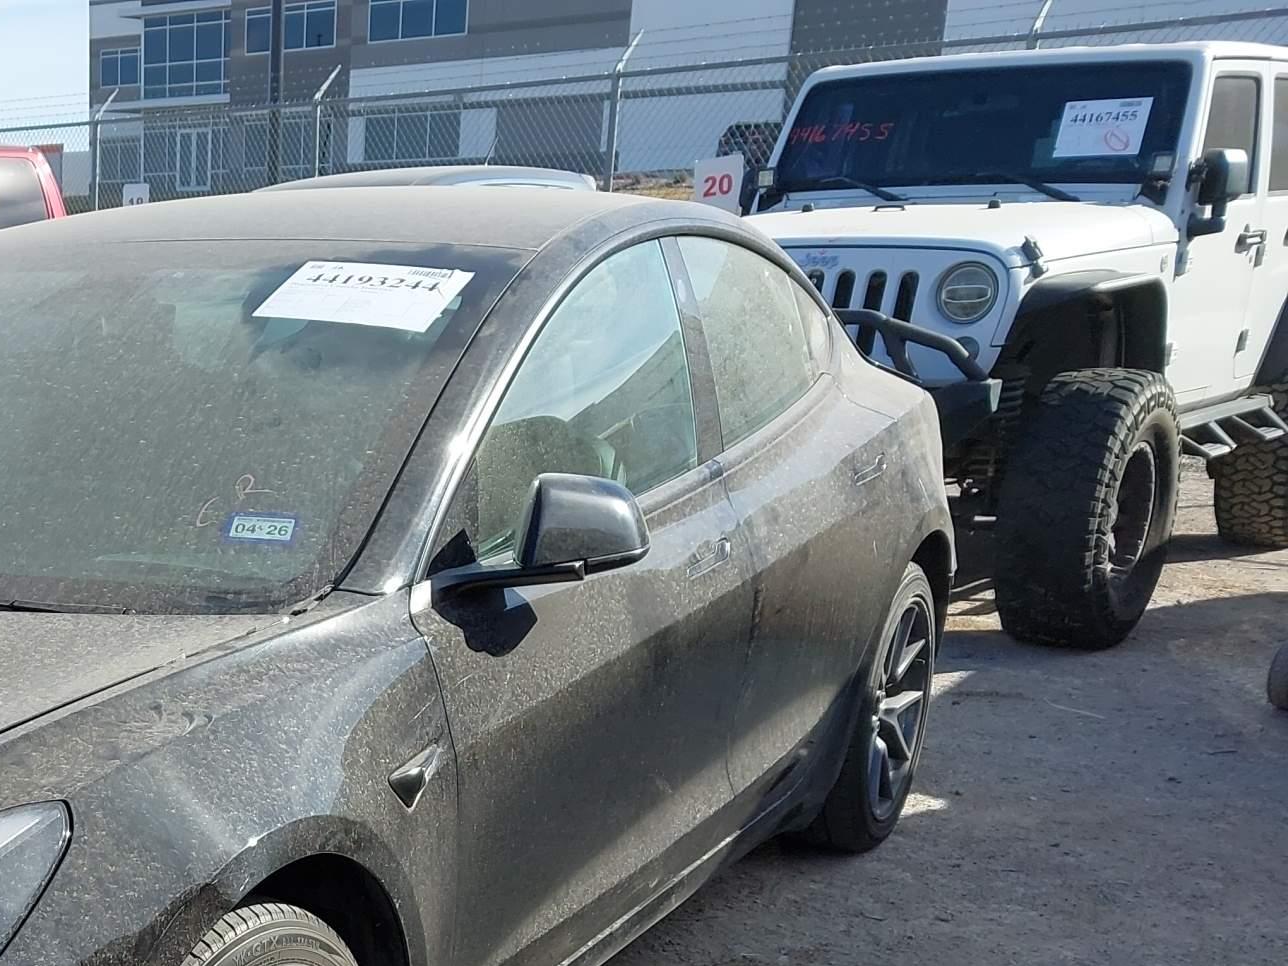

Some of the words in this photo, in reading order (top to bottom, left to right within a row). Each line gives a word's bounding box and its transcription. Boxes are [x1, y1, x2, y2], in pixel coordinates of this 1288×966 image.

[1069, 110, 1139, 124] 44167455
[703, 173, 733, 198] 20
[307, 273, 441, 293] 44193244
[234, 522, 257, 535] 04
[265, 523, 290, 537] 26
